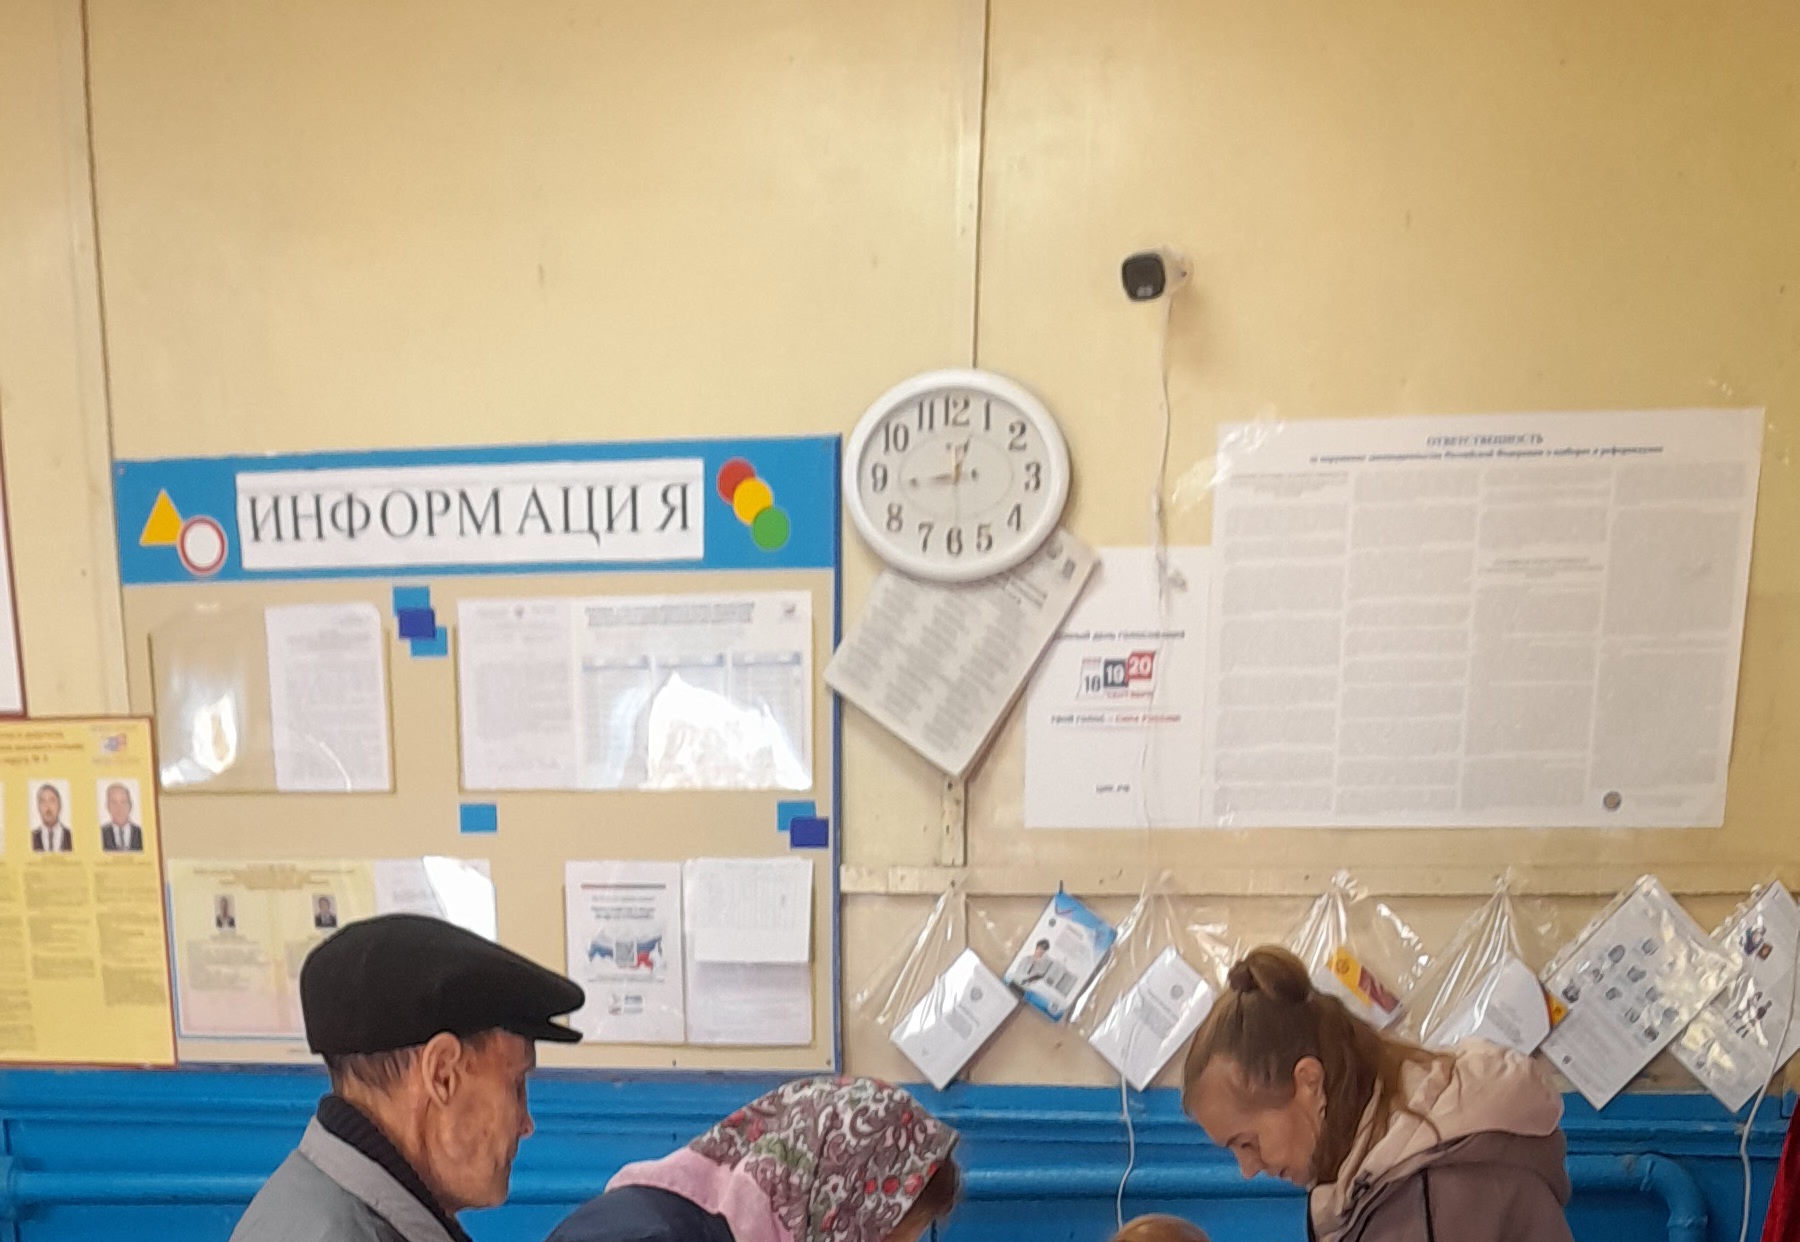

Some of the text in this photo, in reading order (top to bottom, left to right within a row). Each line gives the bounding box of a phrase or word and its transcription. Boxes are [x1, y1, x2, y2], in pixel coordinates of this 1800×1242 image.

[919, 400, 935, 431] 11
[944, 396, 970, 427] 12
[984, 400, 991, 431] 1
[884, 422, 909, 454] 10
[1008, 421, 1027, 450] 2
[871, 462, 888, 492] 9
[1024, 461, 1041, 491] 3
[248, 482, 690, 547] ИНФОРМАЦИЯ
[886, 503, 903, 532] 8
[1007, 502, 1022, 531] 4
[918, 521, 934, 552] 7
[946, 527, 963, 556] 6
[976, 523, 993, 551] 5
[1128, 655, 1152, 676] 20
